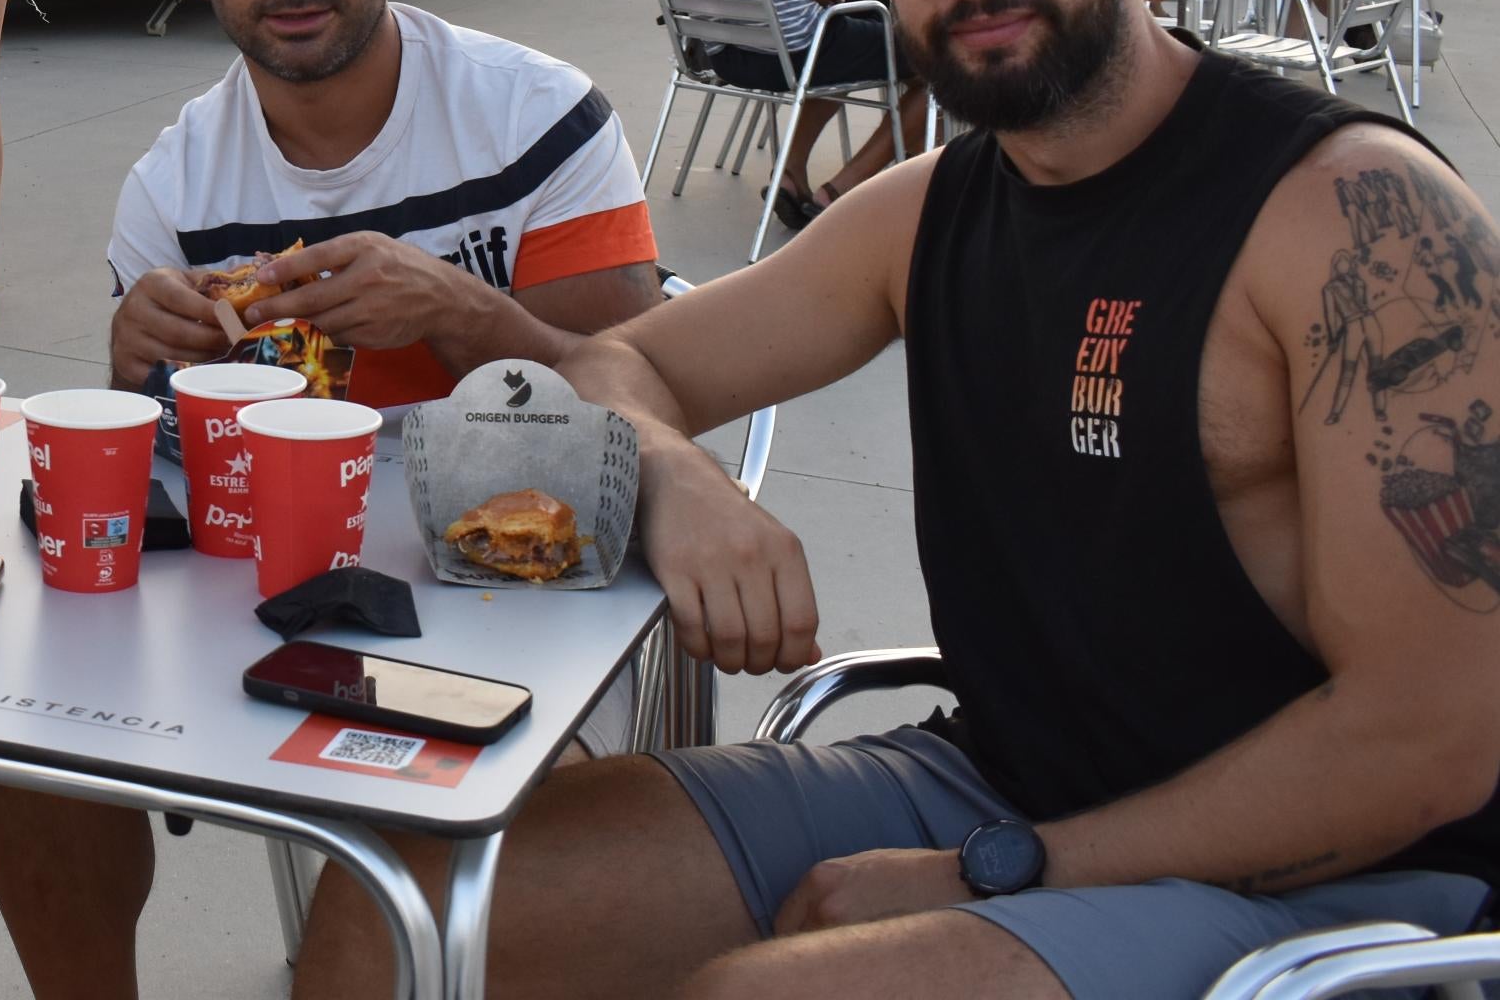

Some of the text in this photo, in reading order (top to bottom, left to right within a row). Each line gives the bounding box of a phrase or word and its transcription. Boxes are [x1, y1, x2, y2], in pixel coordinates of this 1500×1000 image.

[1076, 336, 1128, 375] EDY
[1071, 375, 1124, 417] BUR
[465, 411, 570, 425] ORIGEN BURGERS
[1070, 416, 1121, 458] GER
[209, 474, 250, 488] ESTRE
